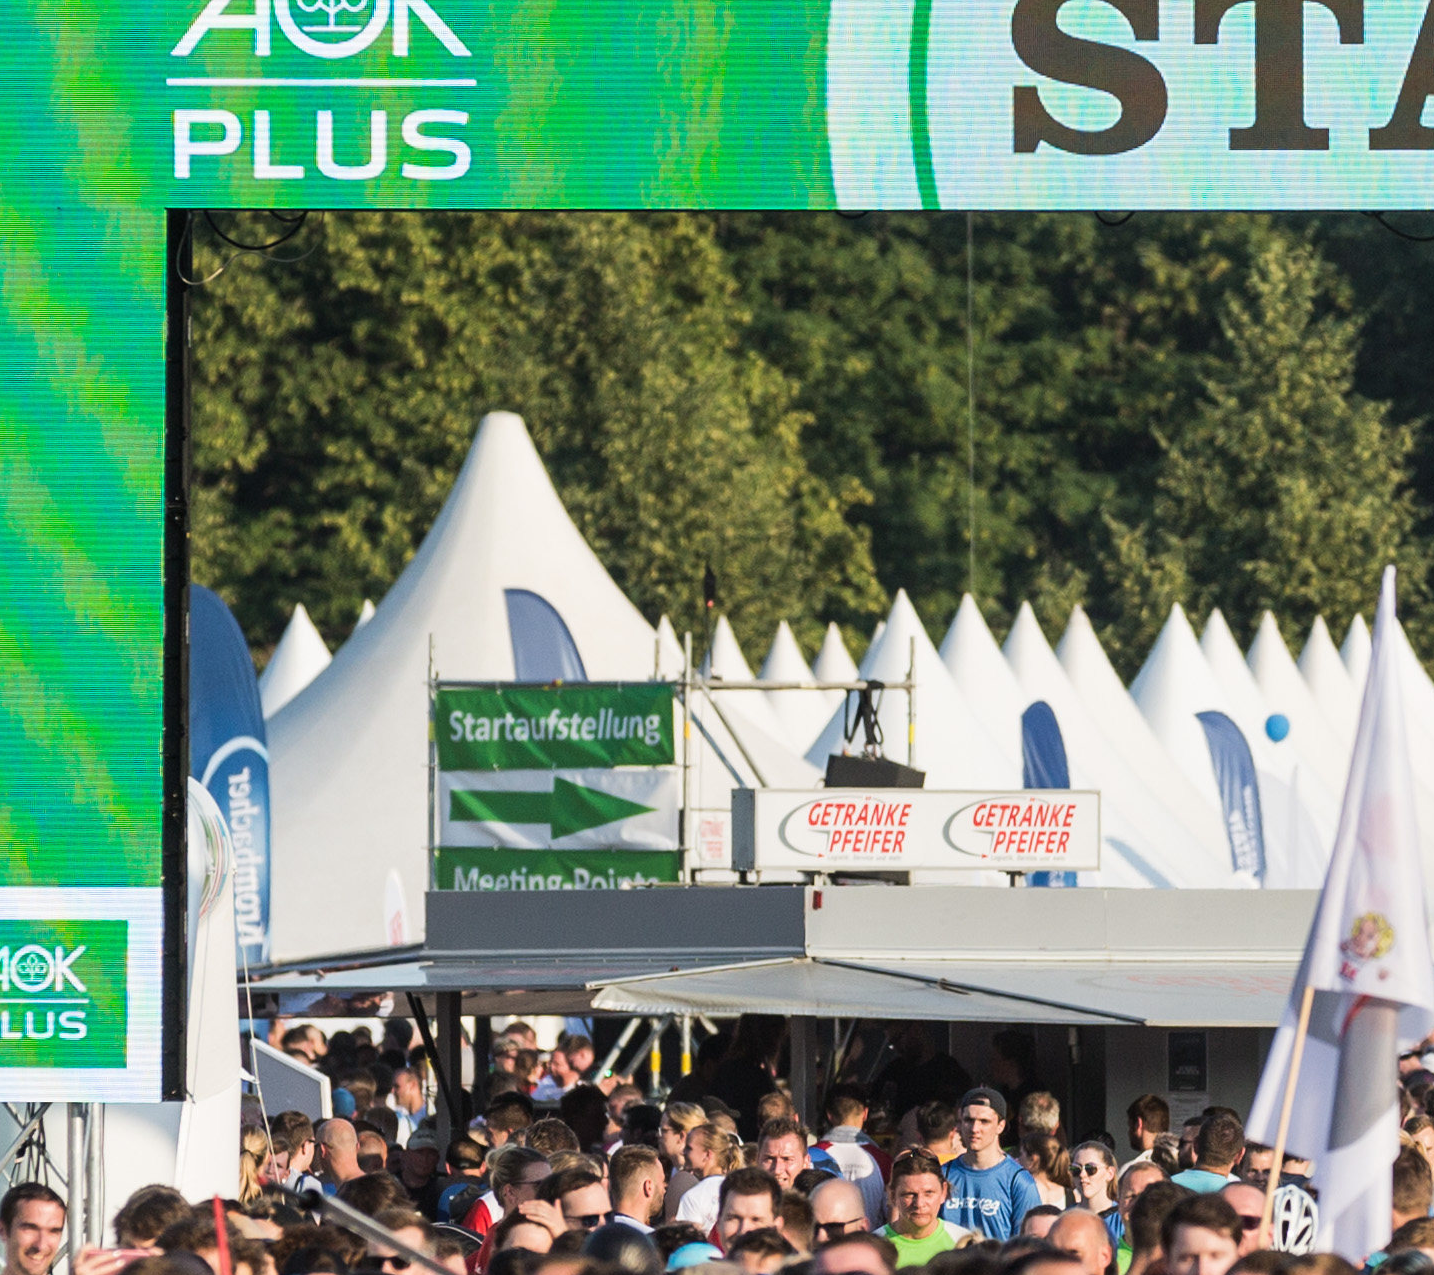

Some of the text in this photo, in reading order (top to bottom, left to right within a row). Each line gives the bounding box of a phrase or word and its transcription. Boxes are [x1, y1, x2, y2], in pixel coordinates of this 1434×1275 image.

[172, 109, 473, 181] PLUS
[449, 708, 662, 747] Startaufstellung
[808, 796, 912, 827] GETRÄNKE
[972, 797, 1077, 827] GETRÄNKE
[829, 829, 906, 854] PFEIFER
[992, 830, 1071, 854] PFEIFER
[945, 1196, 1001, 1217] CHECK24
